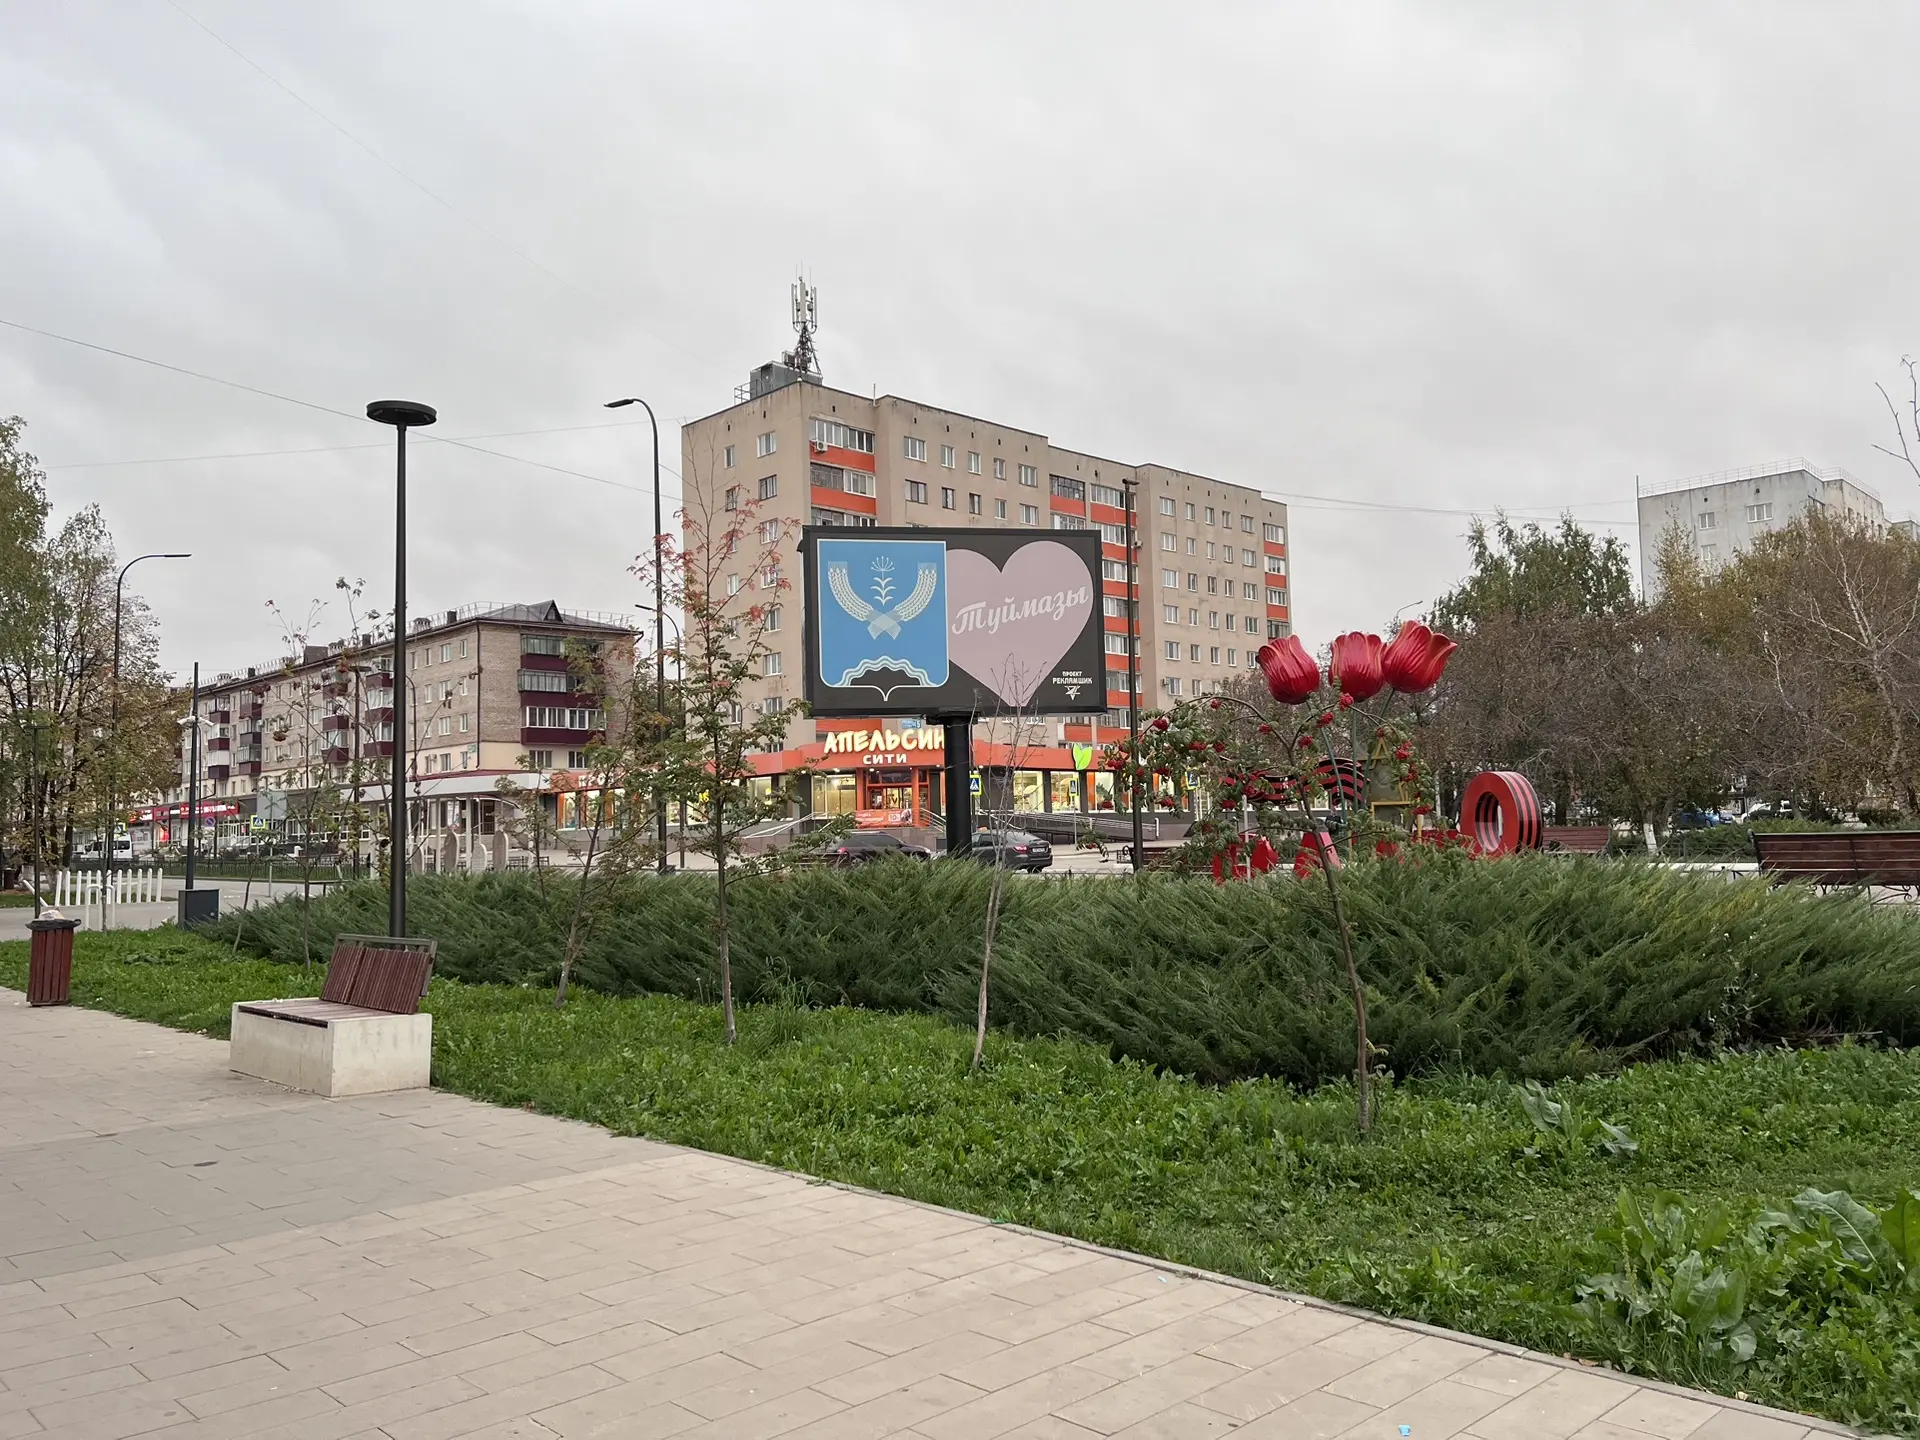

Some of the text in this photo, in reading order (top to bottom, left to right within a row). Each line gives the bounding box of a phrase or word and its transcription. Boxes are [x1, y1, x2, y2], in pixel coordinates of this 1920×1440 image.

[951, 586, 1089, 635] Туймазы
[823, 728, 945, 754] АПЕЛЬСИН
[862, 753, 908, 765] СИТИ
